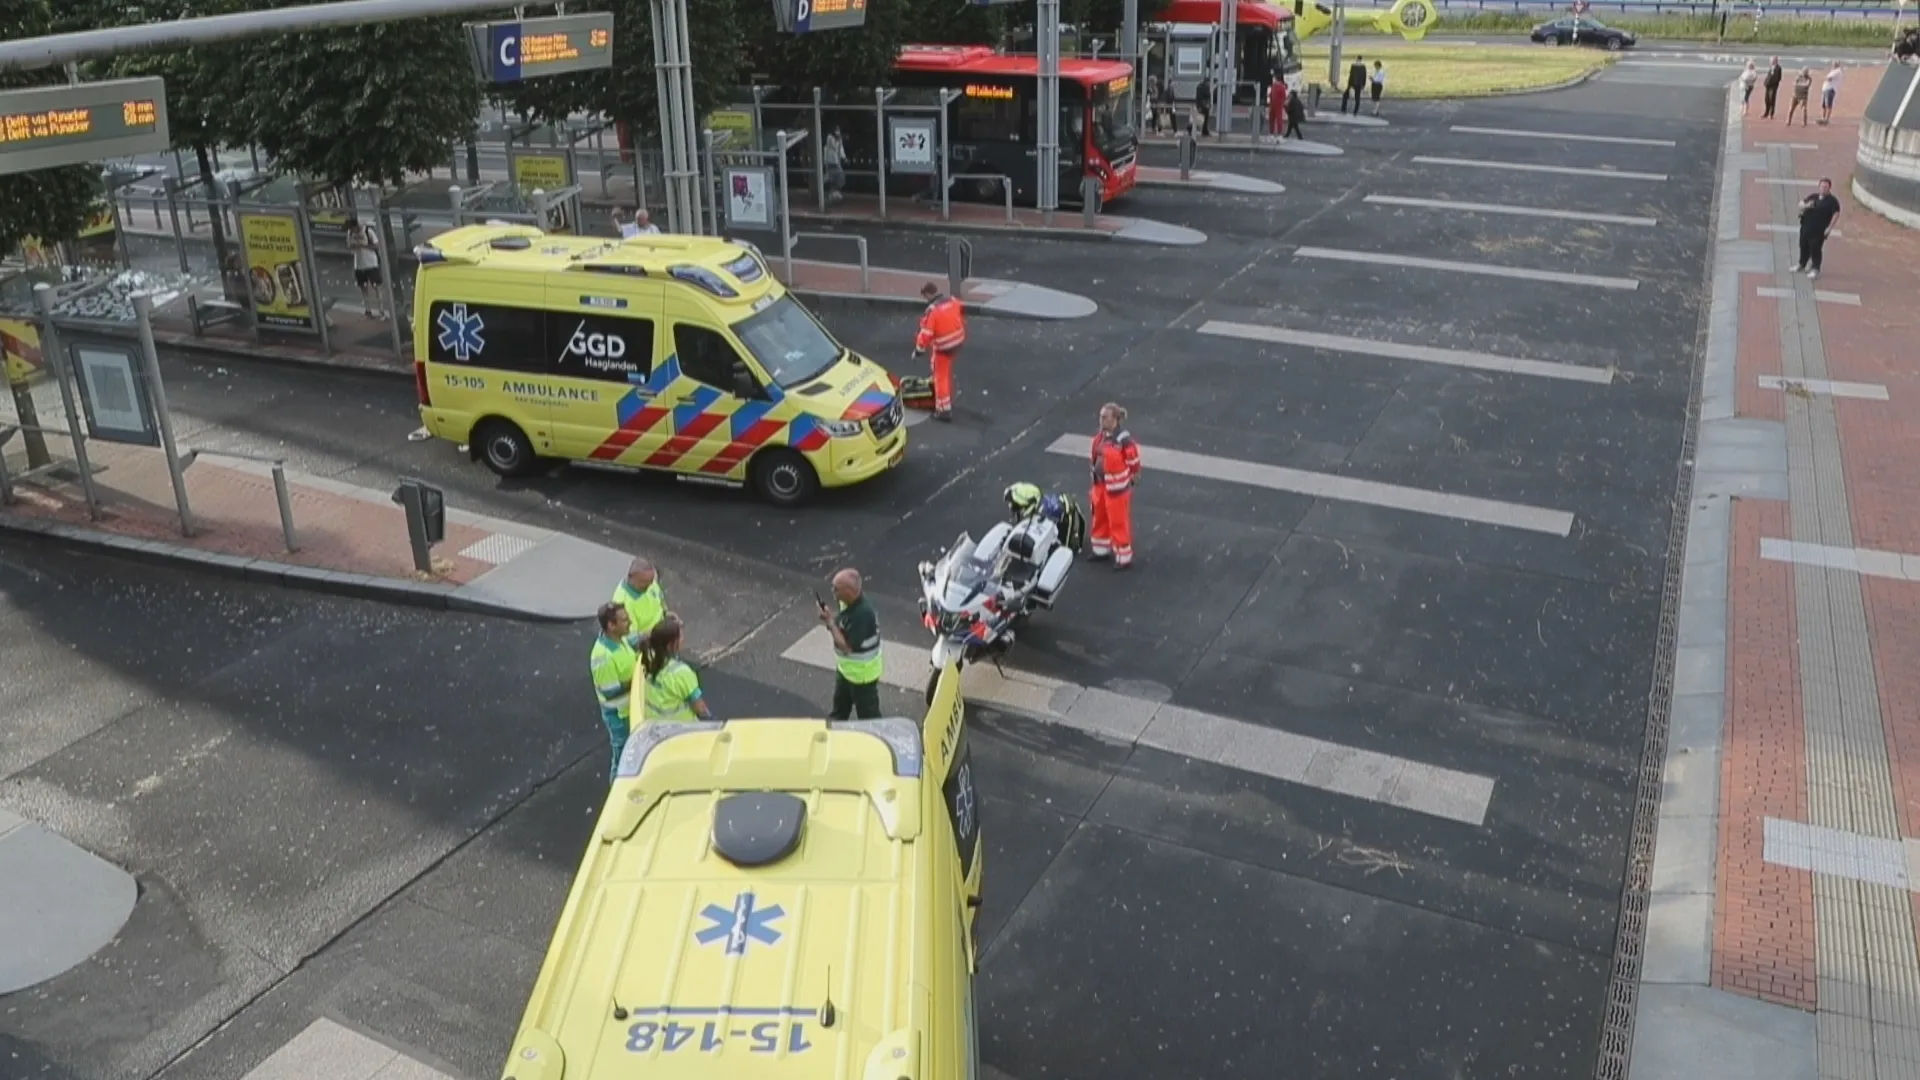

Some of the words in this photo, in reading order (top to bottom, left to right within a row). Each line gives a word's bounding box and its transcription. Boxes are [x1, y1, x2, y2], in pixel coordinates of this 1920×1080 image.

[500, 36, 515, 66] C
[5, 114, 29, 128] Delft
[31, 114, 47, 126] via
[7, 127, 31, 141] Delft
[33, 125, 48, 137] via
[568, 331, 626, 358] GGD
[584, 357, 637, 372] Haaglanden
[444, 373, 485, 389] 15-105
[502, 380, 599, 401] AMBULANCE
[625, 1021, 812, 1053] 15-148
